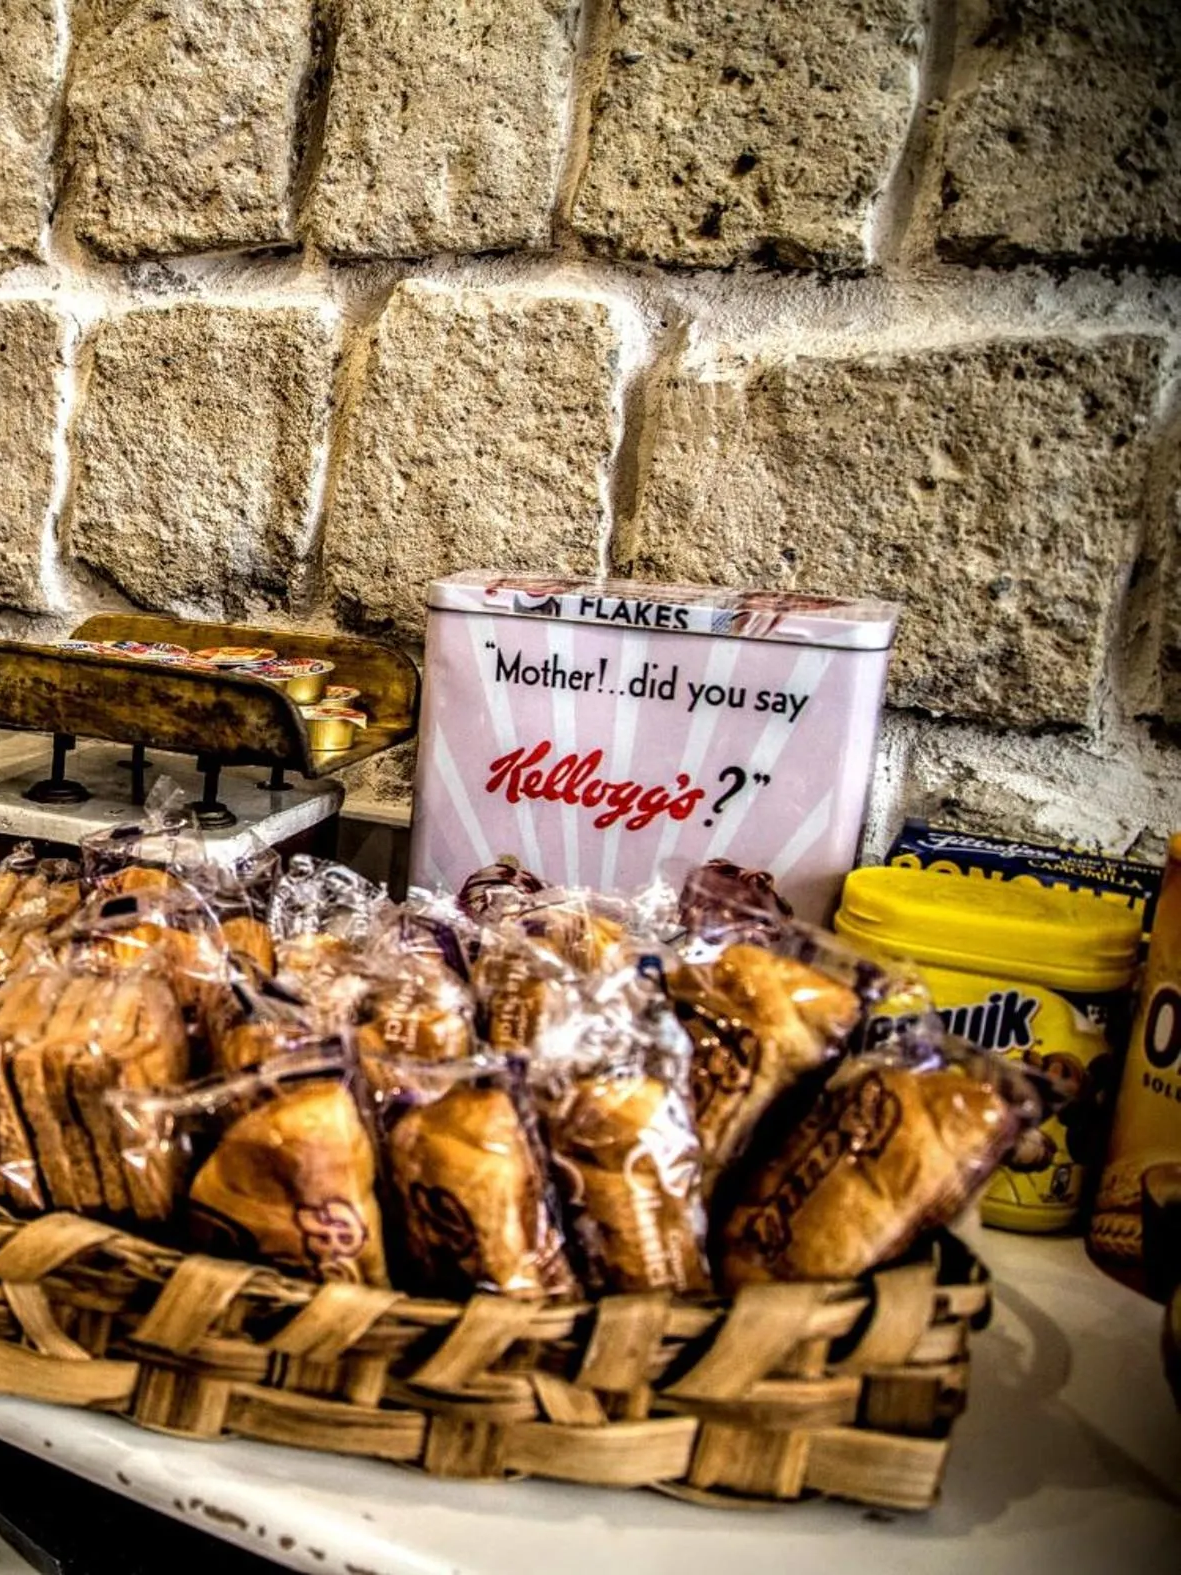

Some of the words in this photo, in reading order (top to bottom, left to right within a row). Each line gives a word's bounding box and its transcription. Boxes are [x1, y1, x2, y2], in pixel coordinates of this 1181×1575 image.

[579, 597, 689, 630] FLAKES
[687, 681, 747, 712] you
[754, 690, 809, 723] say
